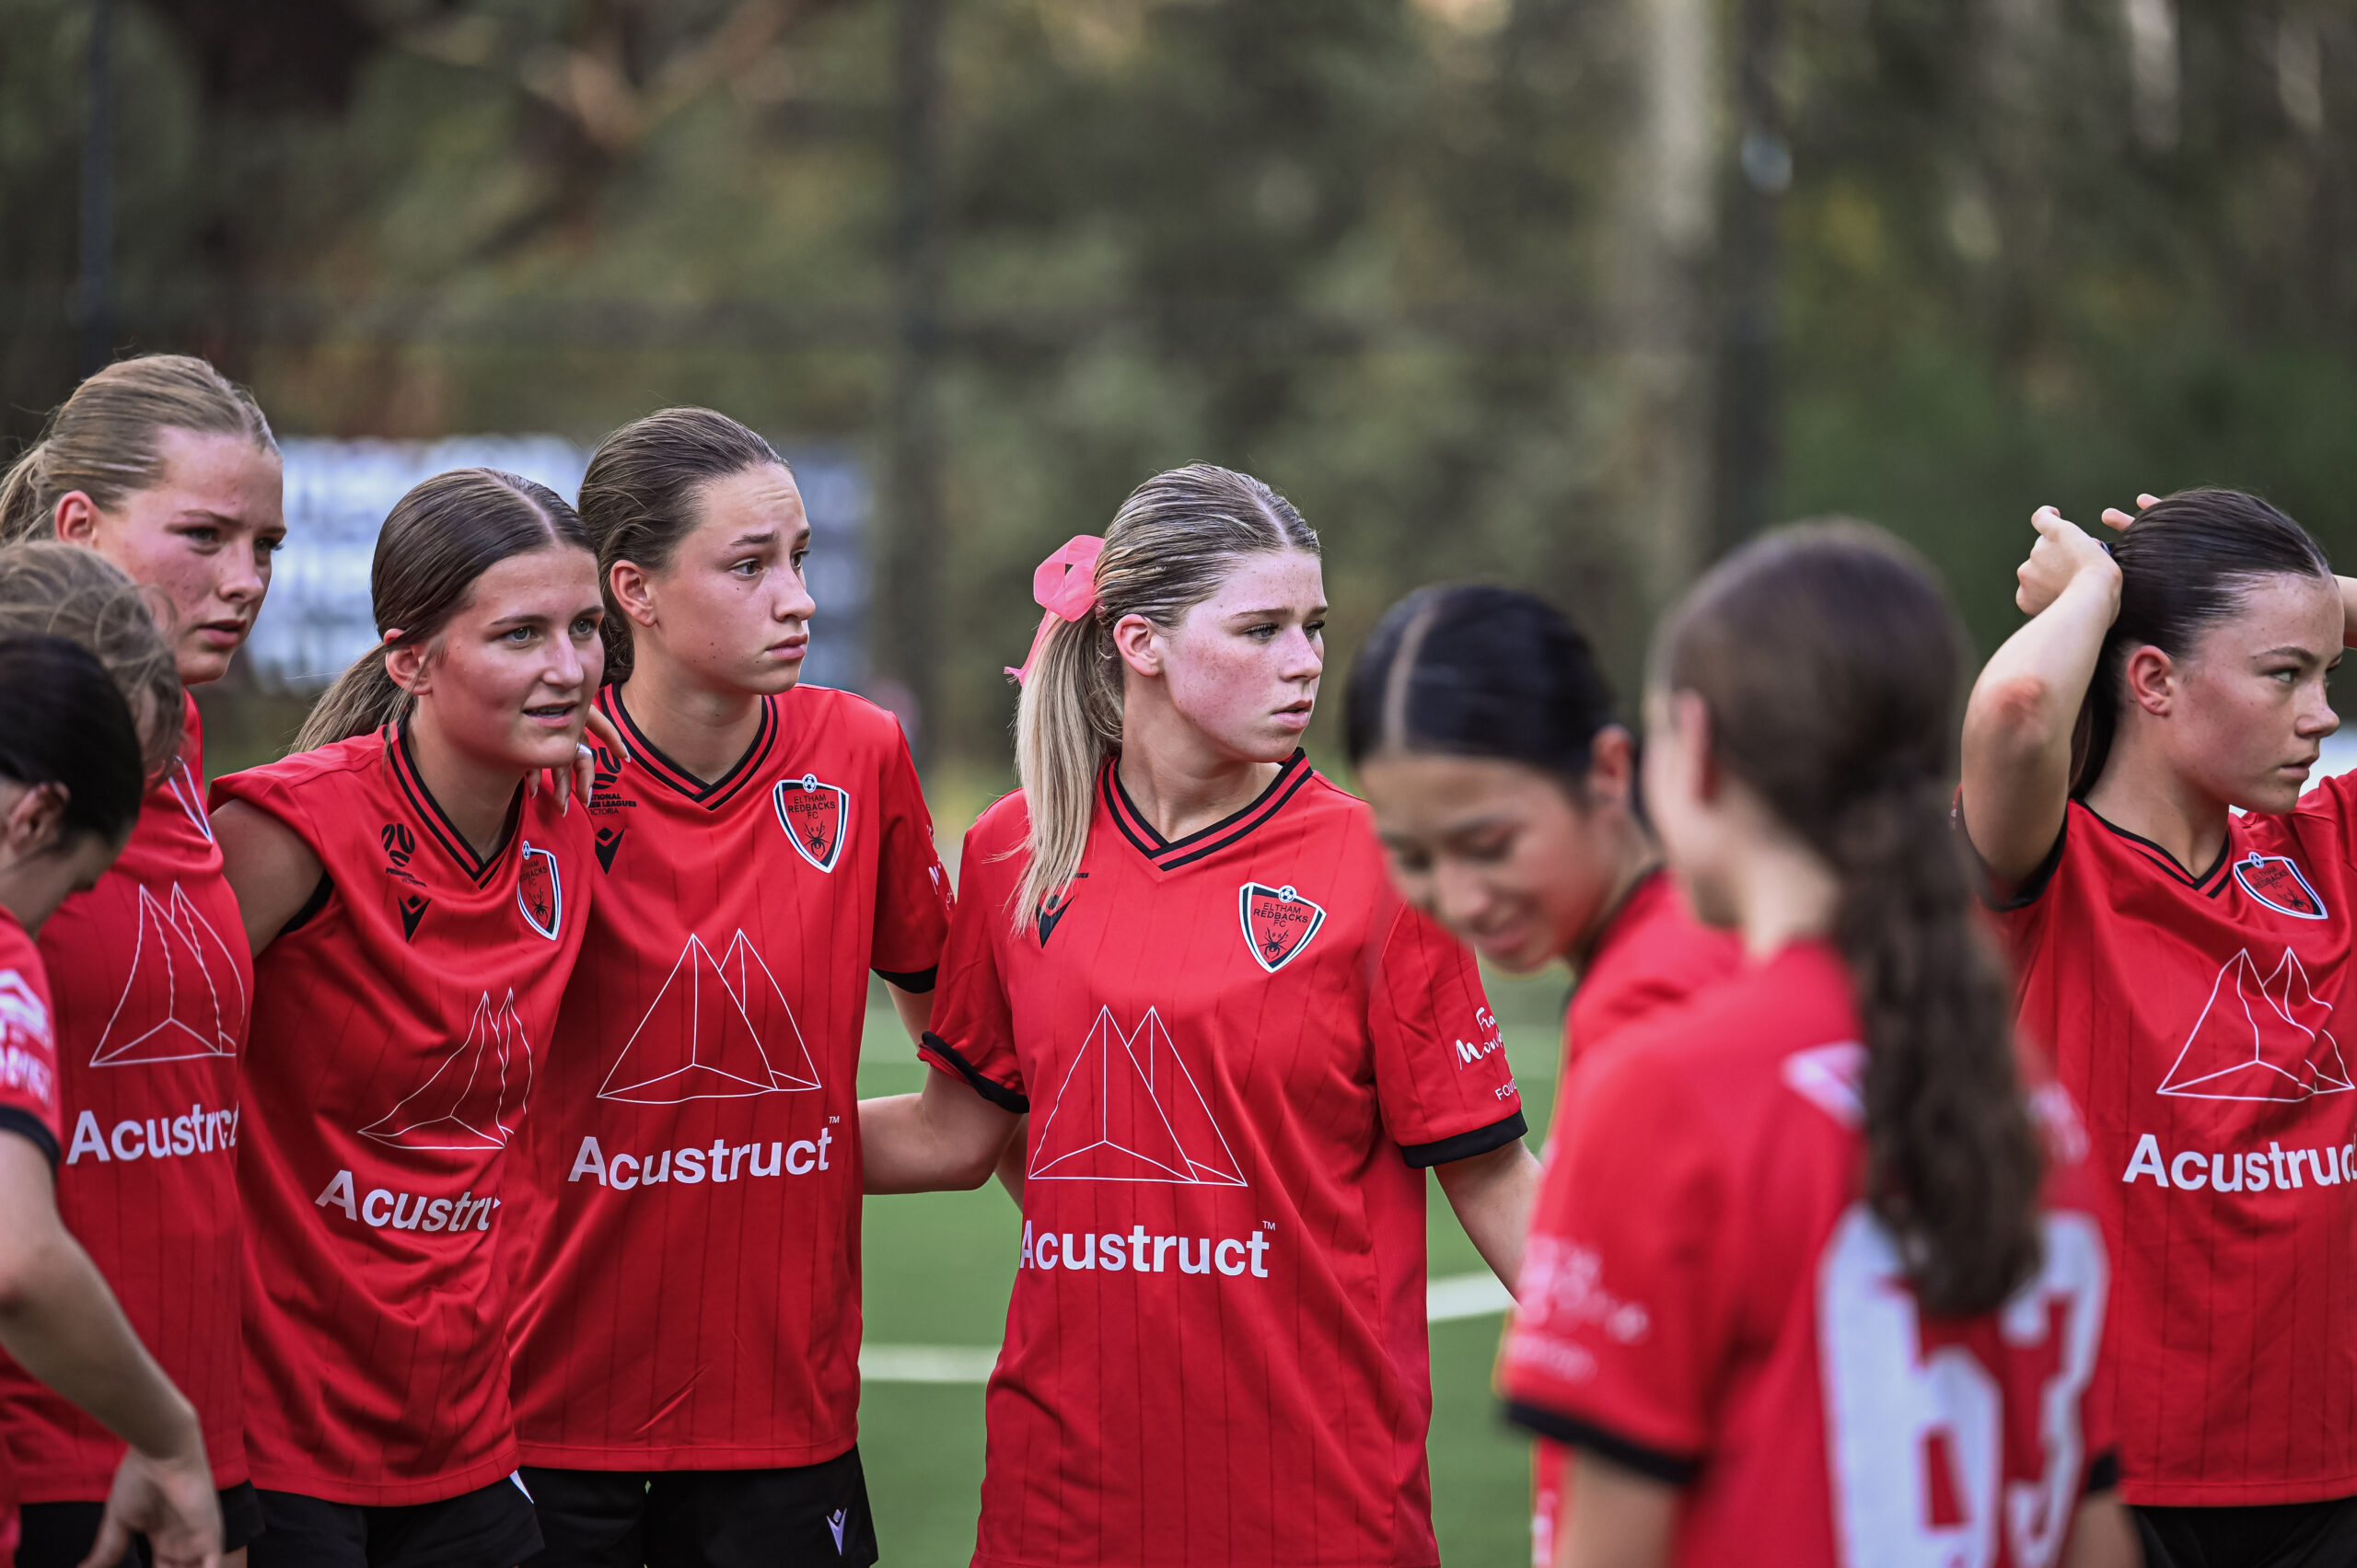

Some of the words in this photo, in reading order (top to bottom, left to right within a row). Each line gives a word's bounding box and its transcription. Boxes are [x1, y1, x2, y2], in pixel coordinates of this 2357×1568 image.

[794, 795, 827, 804] ELTHAM
[788, 801, 836, 813] REDBACKS
[807, 811, 819, 819] FC
[1263, 902, 1301, 914] ELTHAM
[1253, 908, 1308, 923] REDBACKS
[1273, 920, 1286, 928] FC
[568, 1127, 832, 1191] Acustruct
[1019, 1220, 1270, 1278] Acustruct
